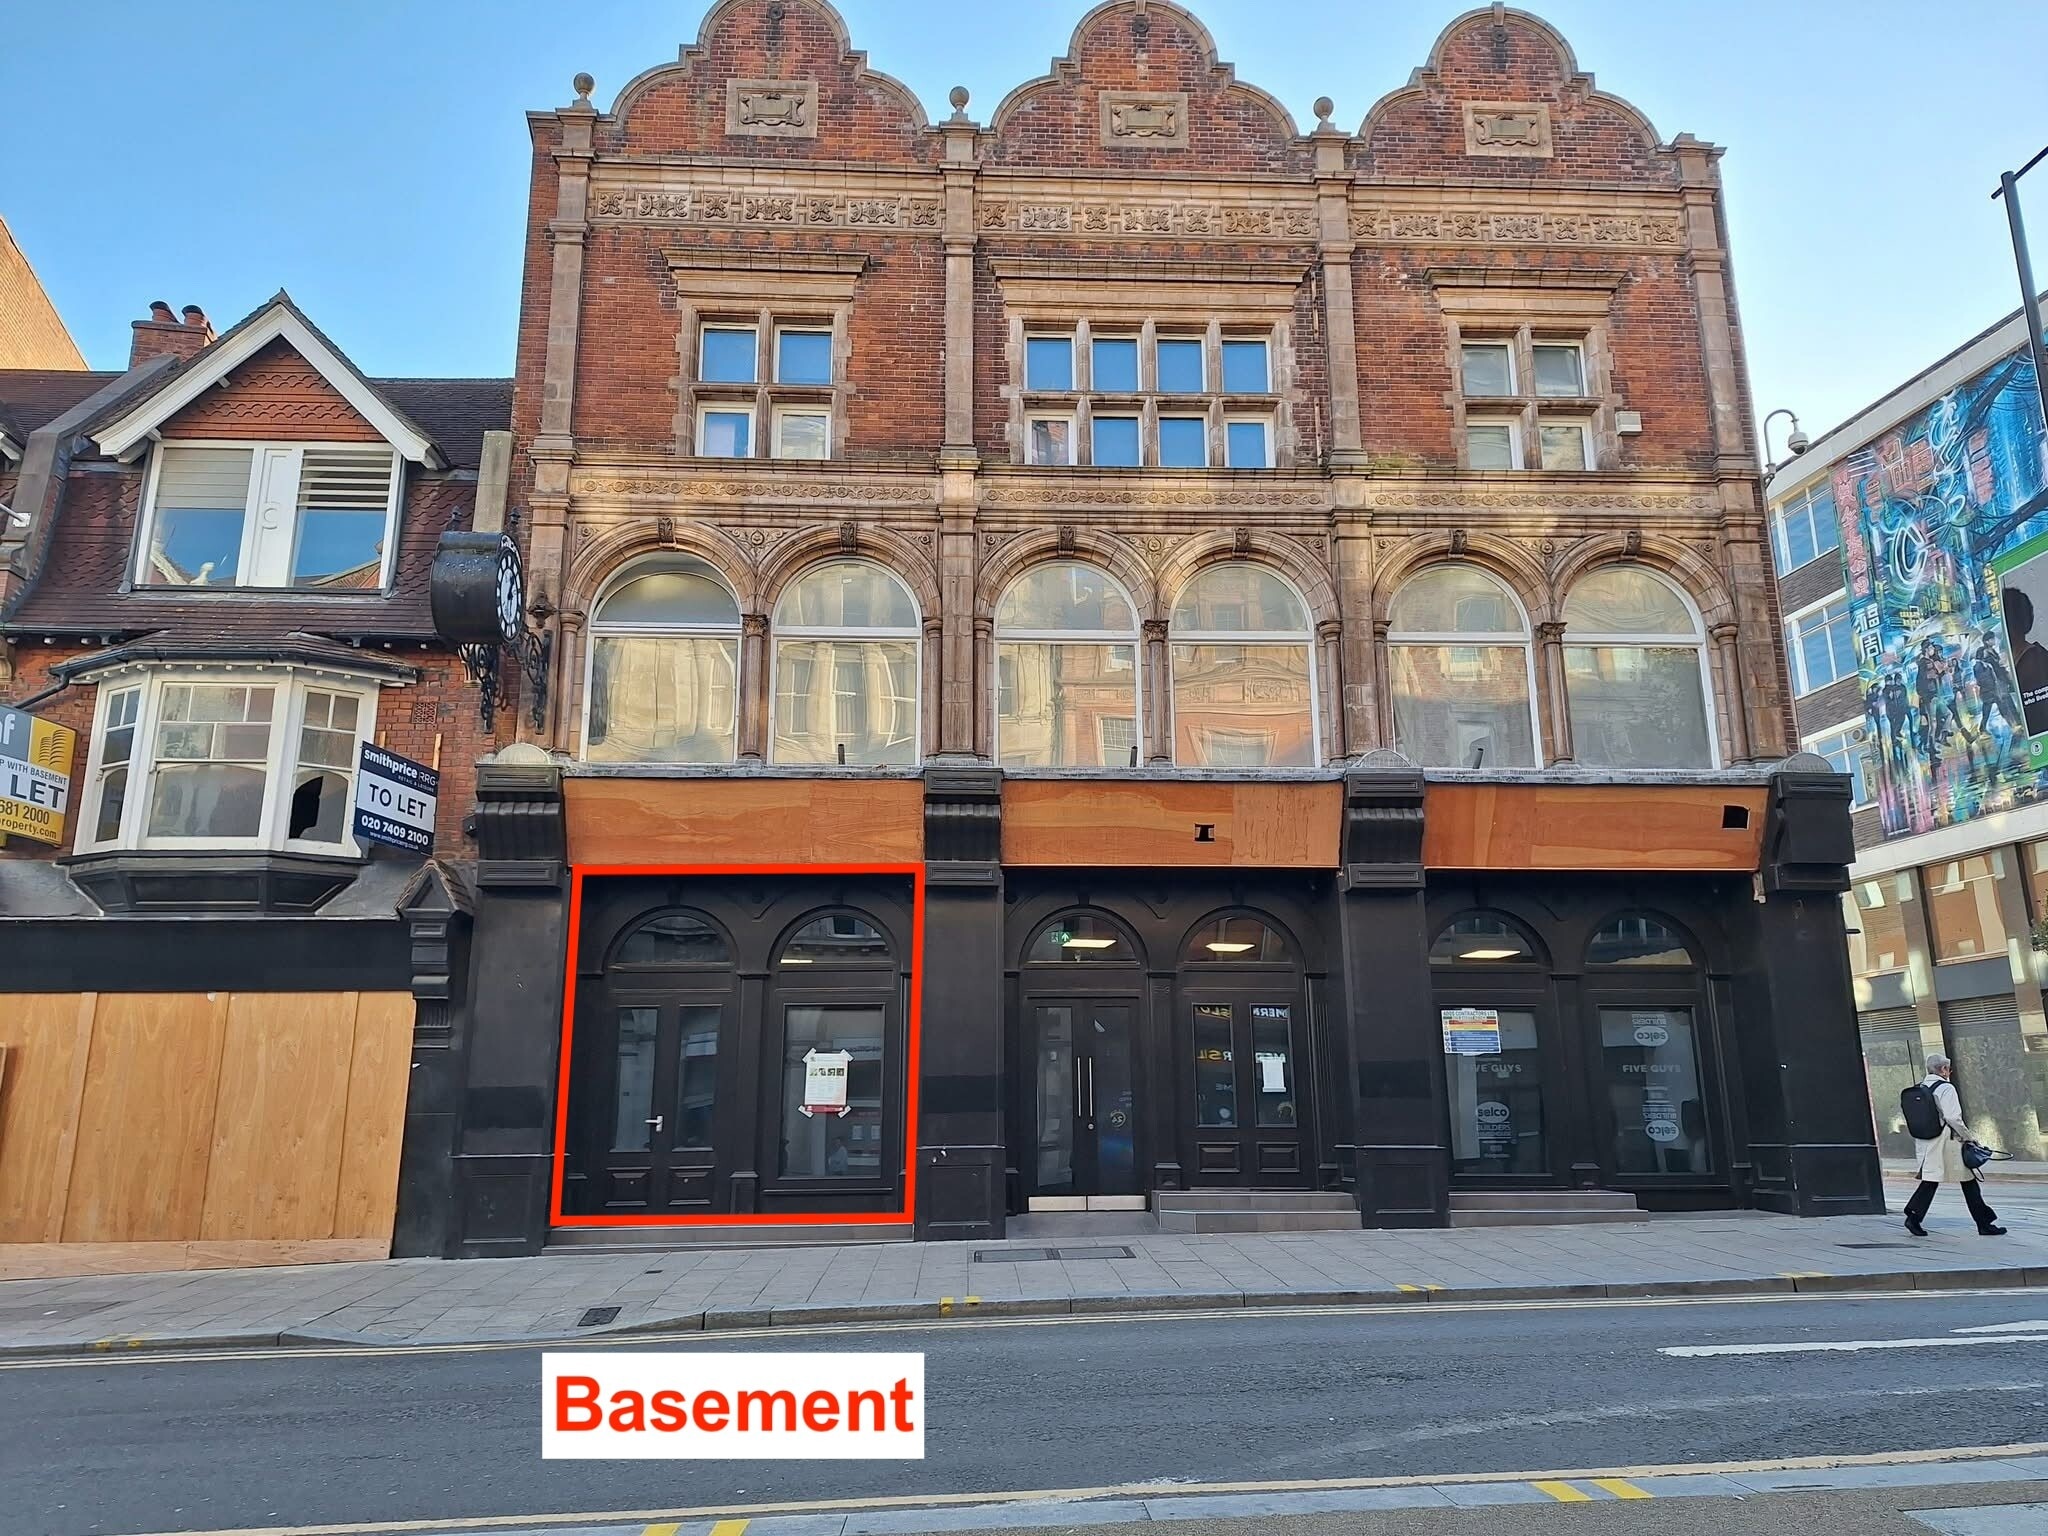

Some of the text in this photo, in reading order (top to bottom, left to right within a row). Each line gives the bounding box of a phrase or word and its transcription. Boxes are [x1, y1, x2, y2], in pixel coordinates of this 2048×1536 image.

[7, 760, 28, 774] WITH
[30, 769, 67, 785] BASEMENT
[364, 749, 436, 786] smithprice RRG
[10, 774, 65, 808] LET
[369, 783, 427, 819] TO LET
[23, 805, 50, 825] 2000
[0, 819, 57, 839] roperty.com
[361, 815, 429, 845] 020 7409 2100
[1491, 1064, 1522, 1073] GUYS
[1622, 1064, 1648, 1073] FIVE
[1477, 1106, 1508, 1117] selco
[1648, 1126, 1677, 1136] selco
